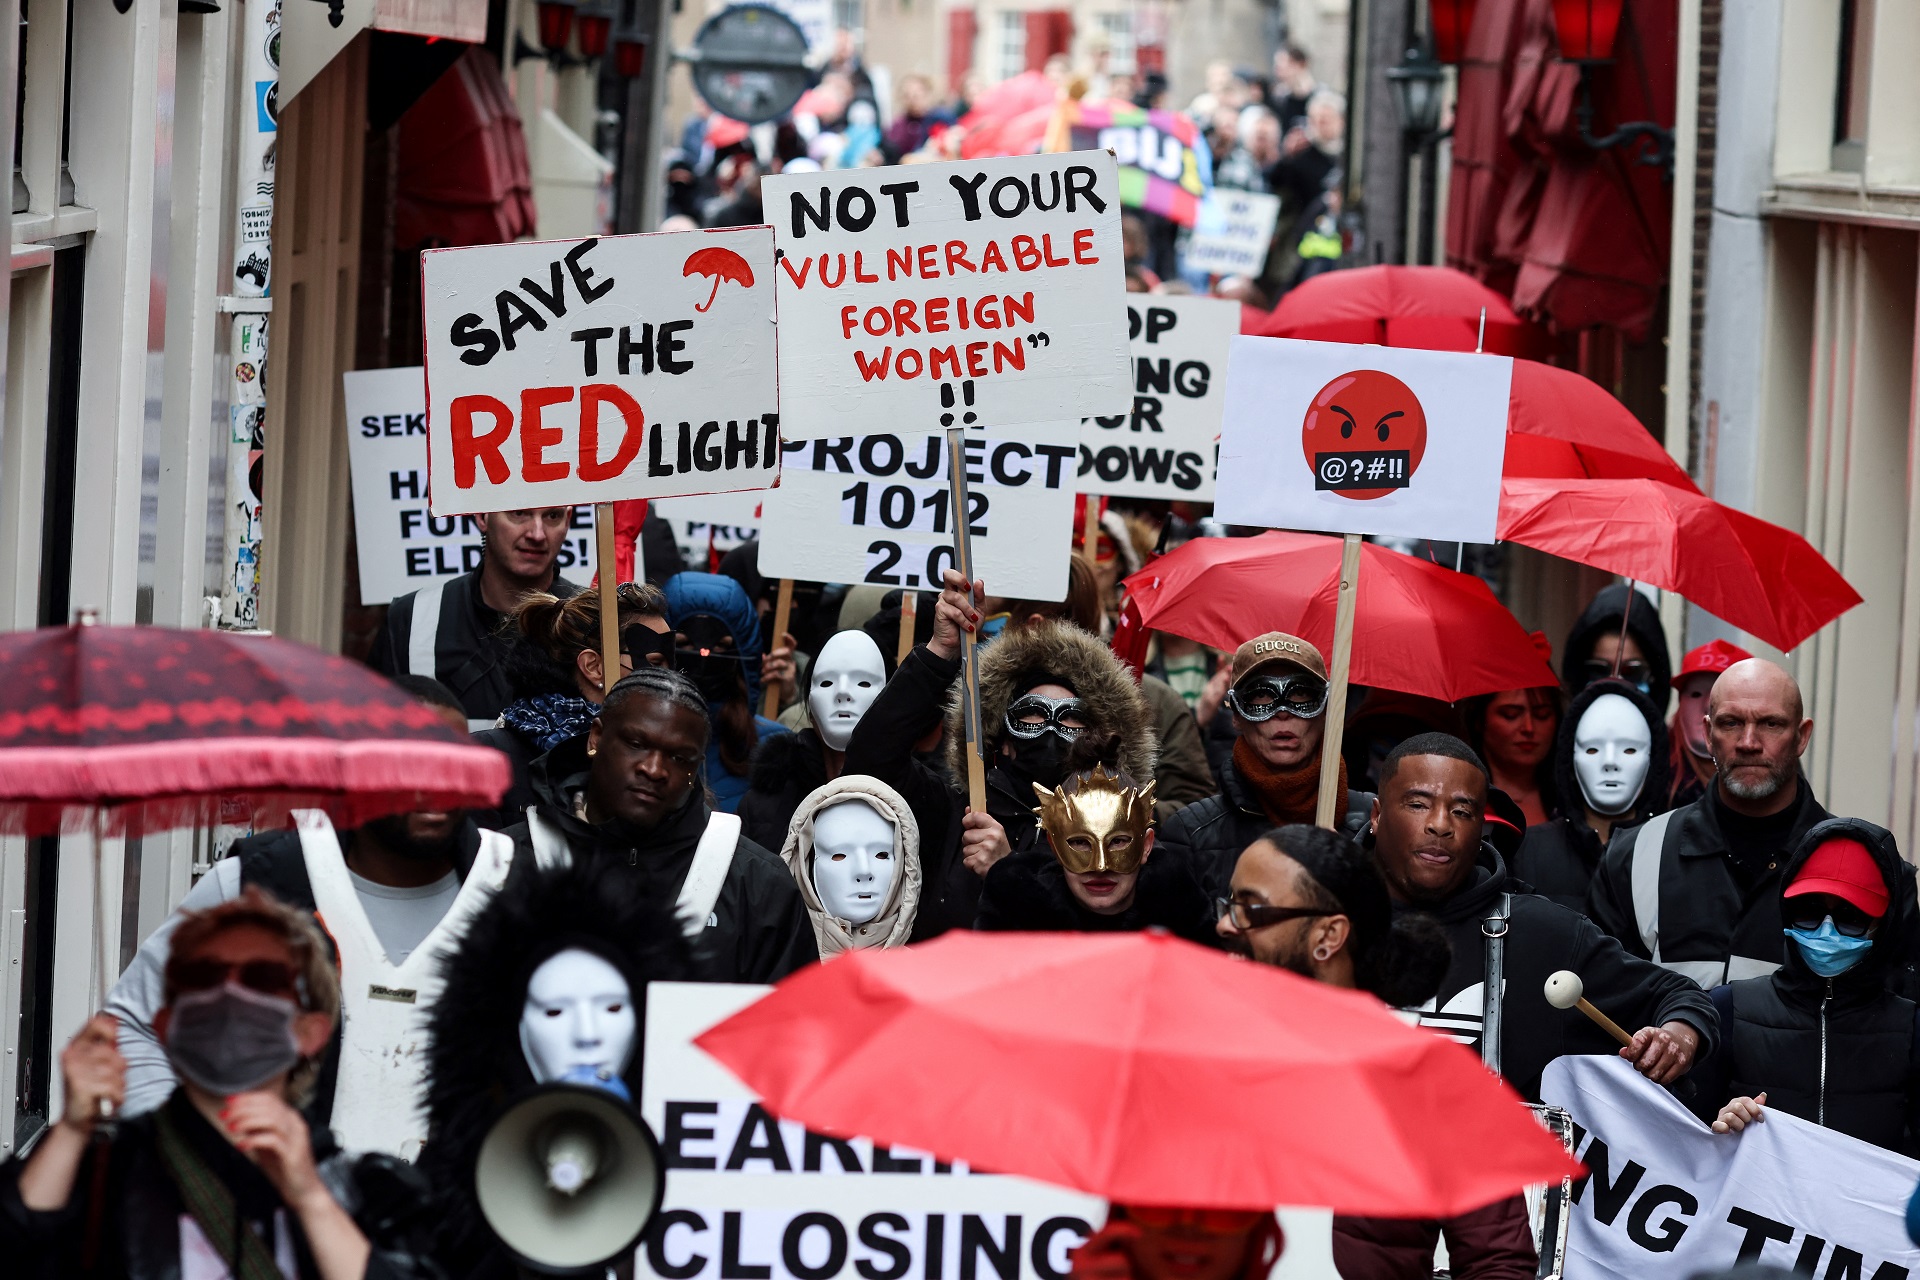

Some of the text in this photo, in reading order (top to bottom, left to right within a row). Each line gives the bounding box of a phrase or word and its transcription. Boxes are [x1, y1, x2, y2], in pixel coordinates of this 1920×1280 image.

[790, 165, 1107, 238] NOT YOUR
[450, 237, 616, 367] SAVE
[841, 291, 1035, 339] FOREIGN
[571, 319, 694, 377] THE
[1130, 356, 1211, 399] NG
[361, 413, 427, 438] SEK
[450, 383, 780, 489] RED LIGHT
[841, 481, 990, 537] 1012
[864, 540, 957, 590] 2.0
[1254, 640, 1302, 654] GUCCI
[646, 1209, 1093, 1280] CLOSING
